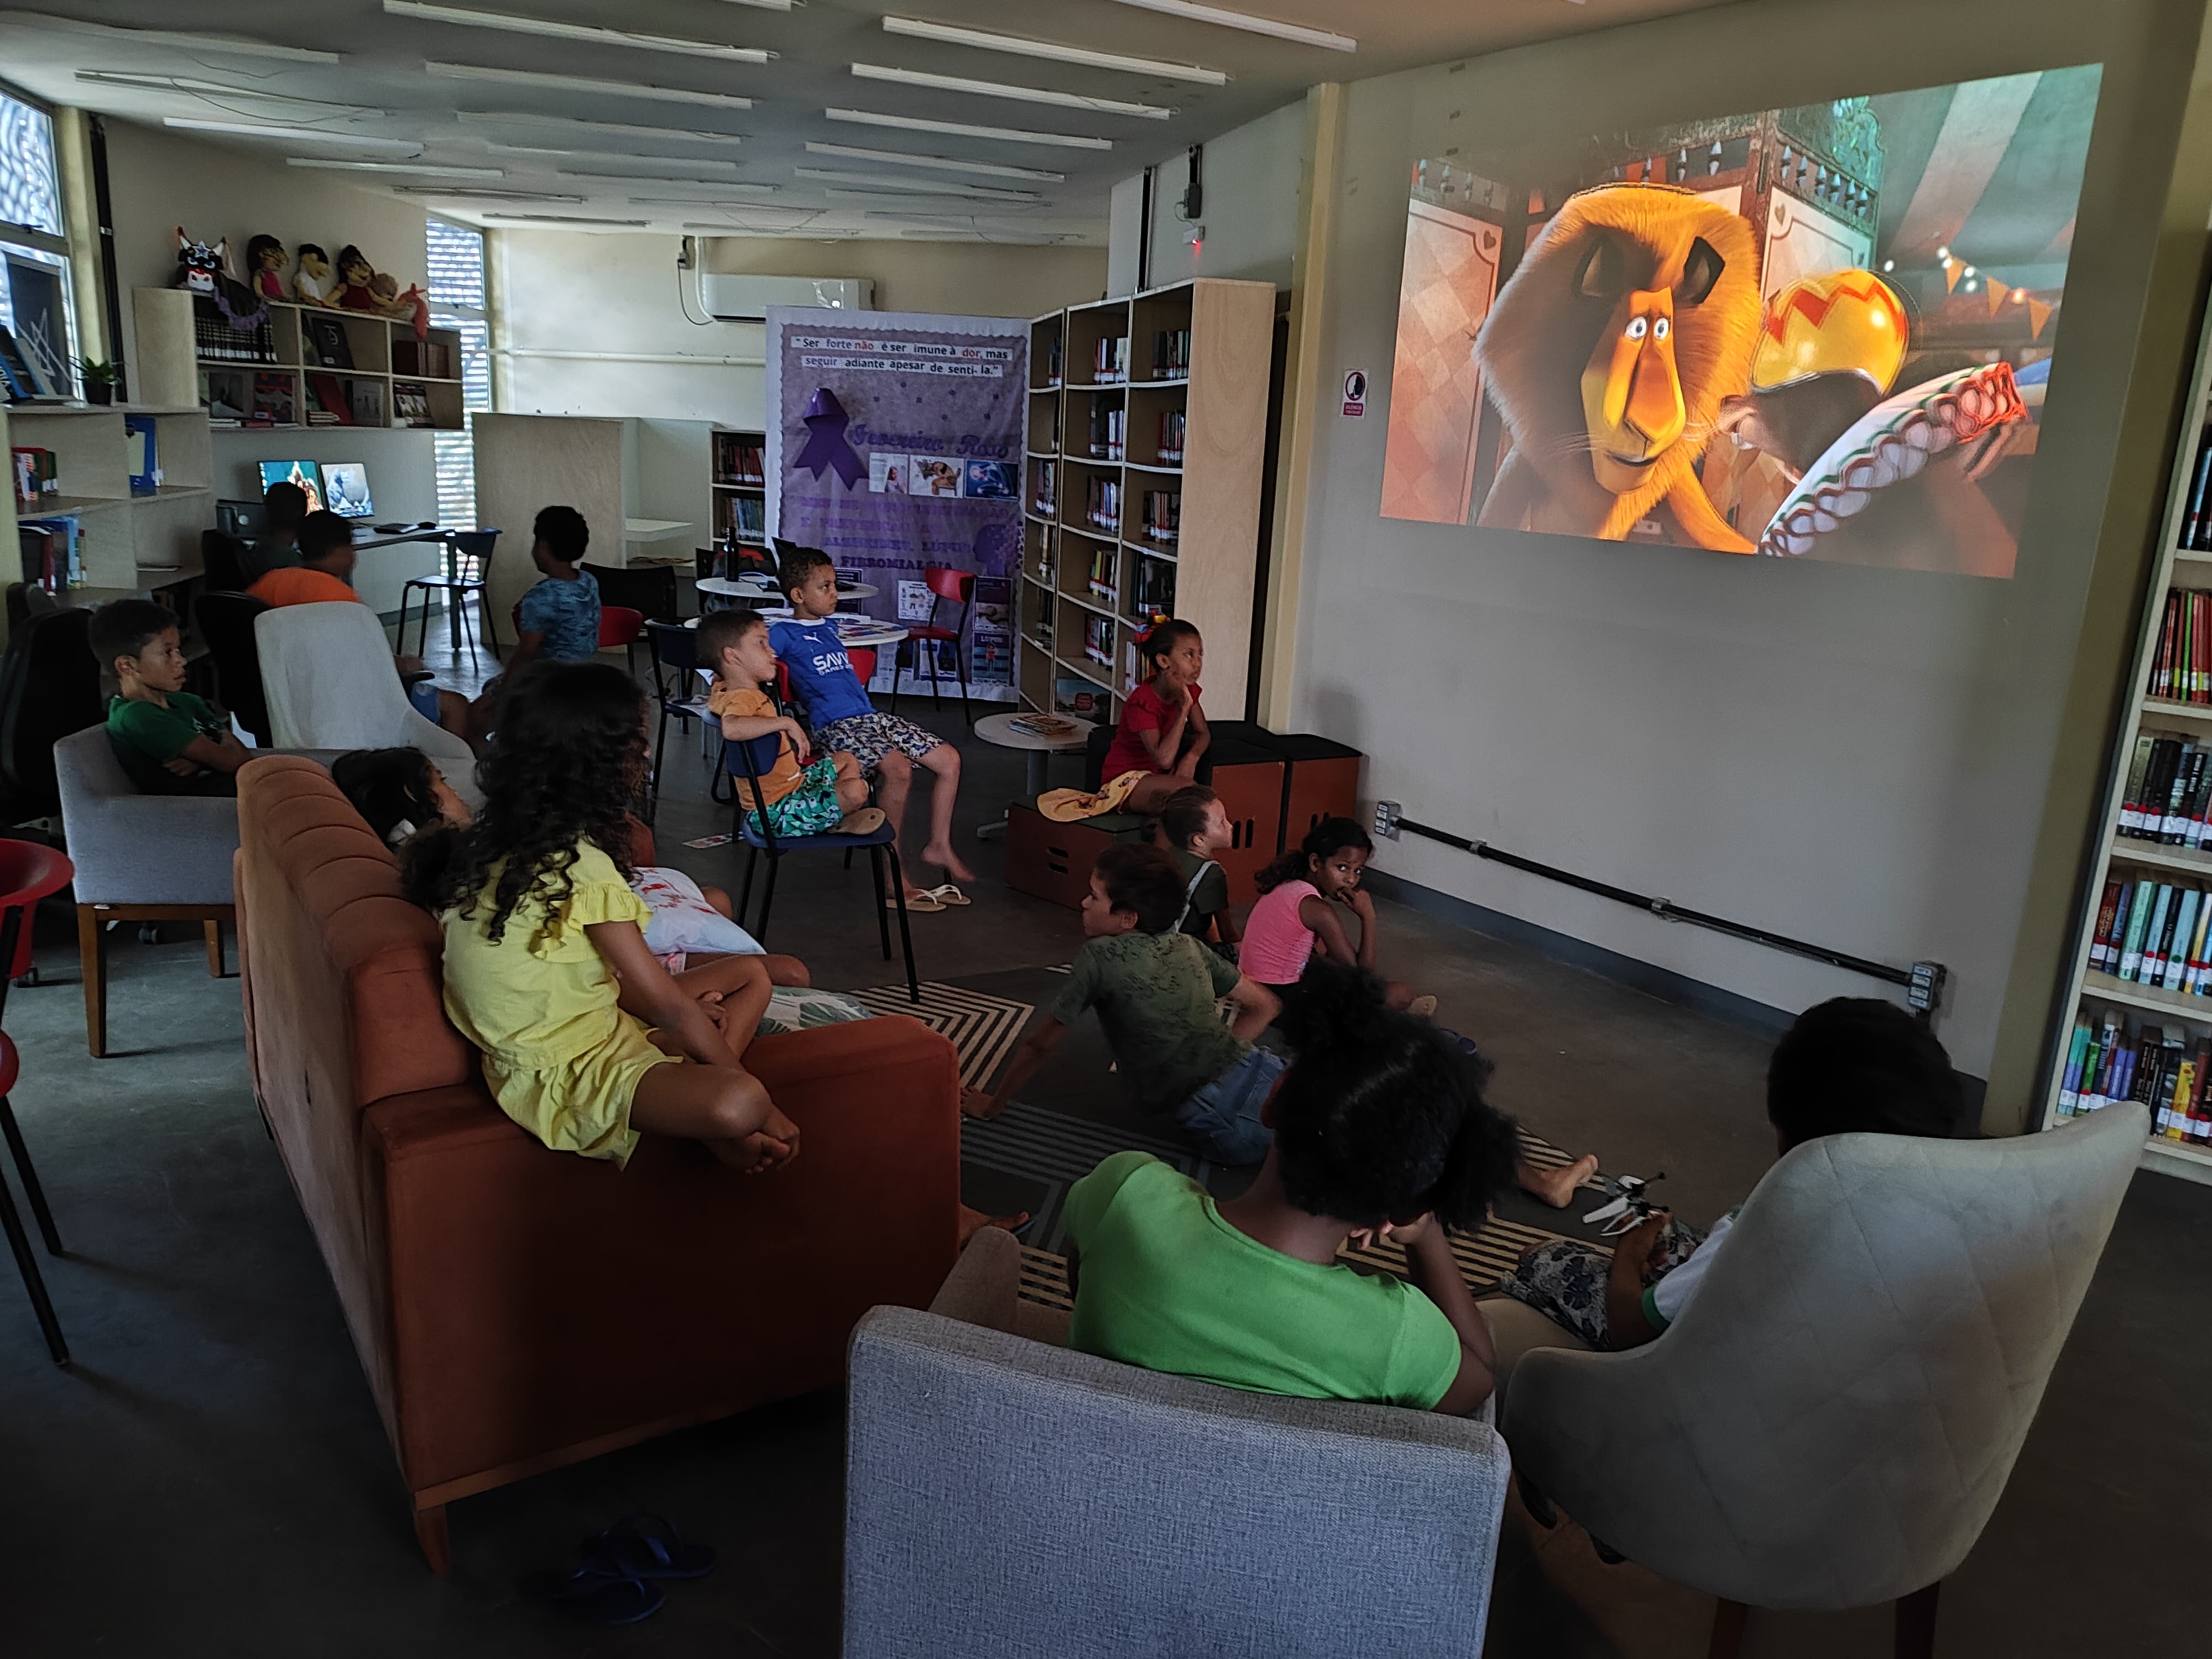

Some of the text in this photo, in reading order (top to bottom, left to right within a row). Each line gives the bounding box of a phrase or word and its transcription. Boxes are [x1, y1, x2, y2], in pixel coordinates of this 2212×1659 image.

[826, 340, 852, 349] forte
[854, 341, 874, 350] não
[881, 342, 888, 351] é
[891, 343, 907, 352] ser
[914, 345, 947, 355] imune
[950, 345, 956, 356] à
[962, 347, 983, 358] dor,
[986, 351, 1008, 359] mas
[805, 357, 837, 368] seguir
[845, 358, 885, 369] adiante
[890, 361, 925, 373] apesar
[930, 362, 943, 373] de
